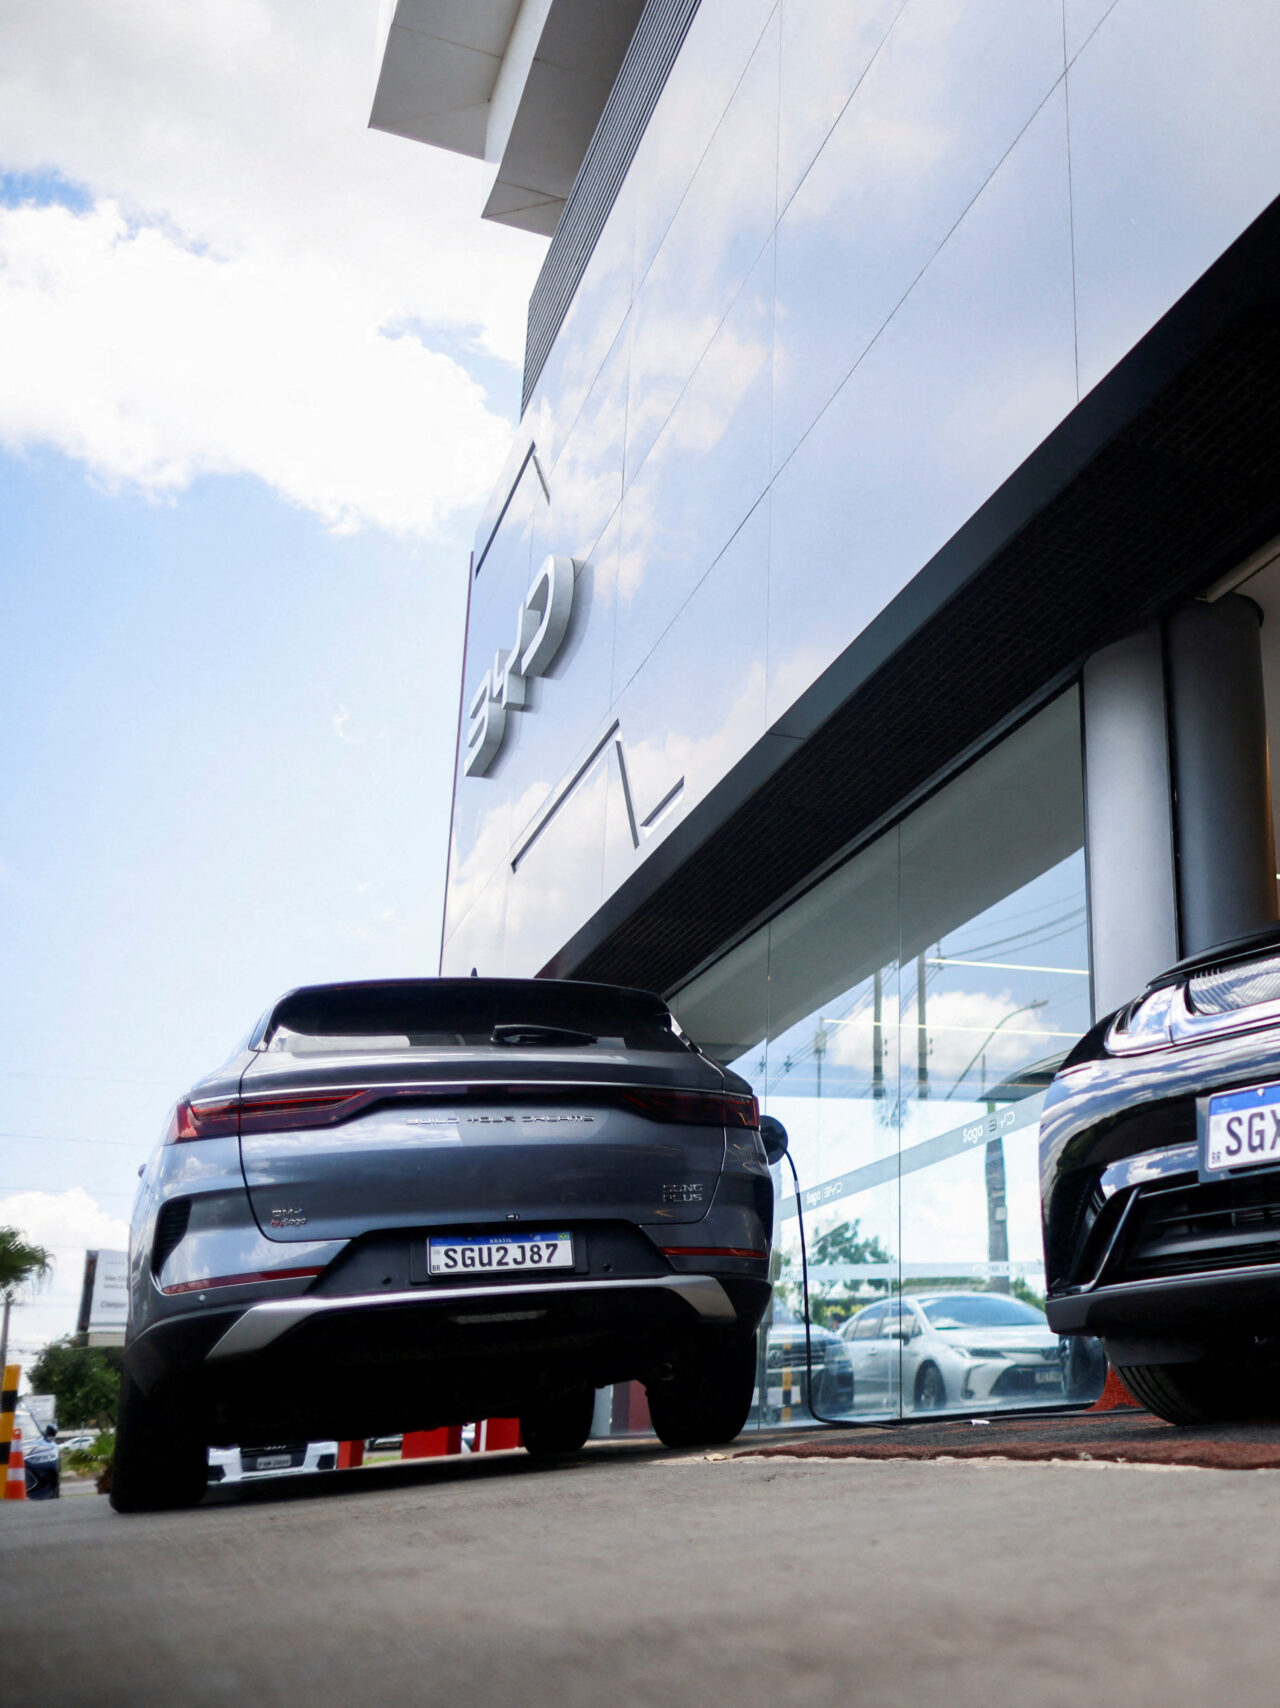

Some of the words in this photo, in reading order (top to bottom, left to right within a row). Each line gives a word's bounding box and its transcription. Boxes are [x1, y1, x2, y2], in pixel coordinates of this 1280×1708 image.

[963, 1124, 984, 1144] Saga
[989, 1111, 1016, 1132] BYD
[1211, 1151, 1222, 1164] BR
[663, 1193, 703, 1202] PLUS
[443, 1243, 559, 1269] SGU2J87
[432, 1264, 441, 1272] BR
